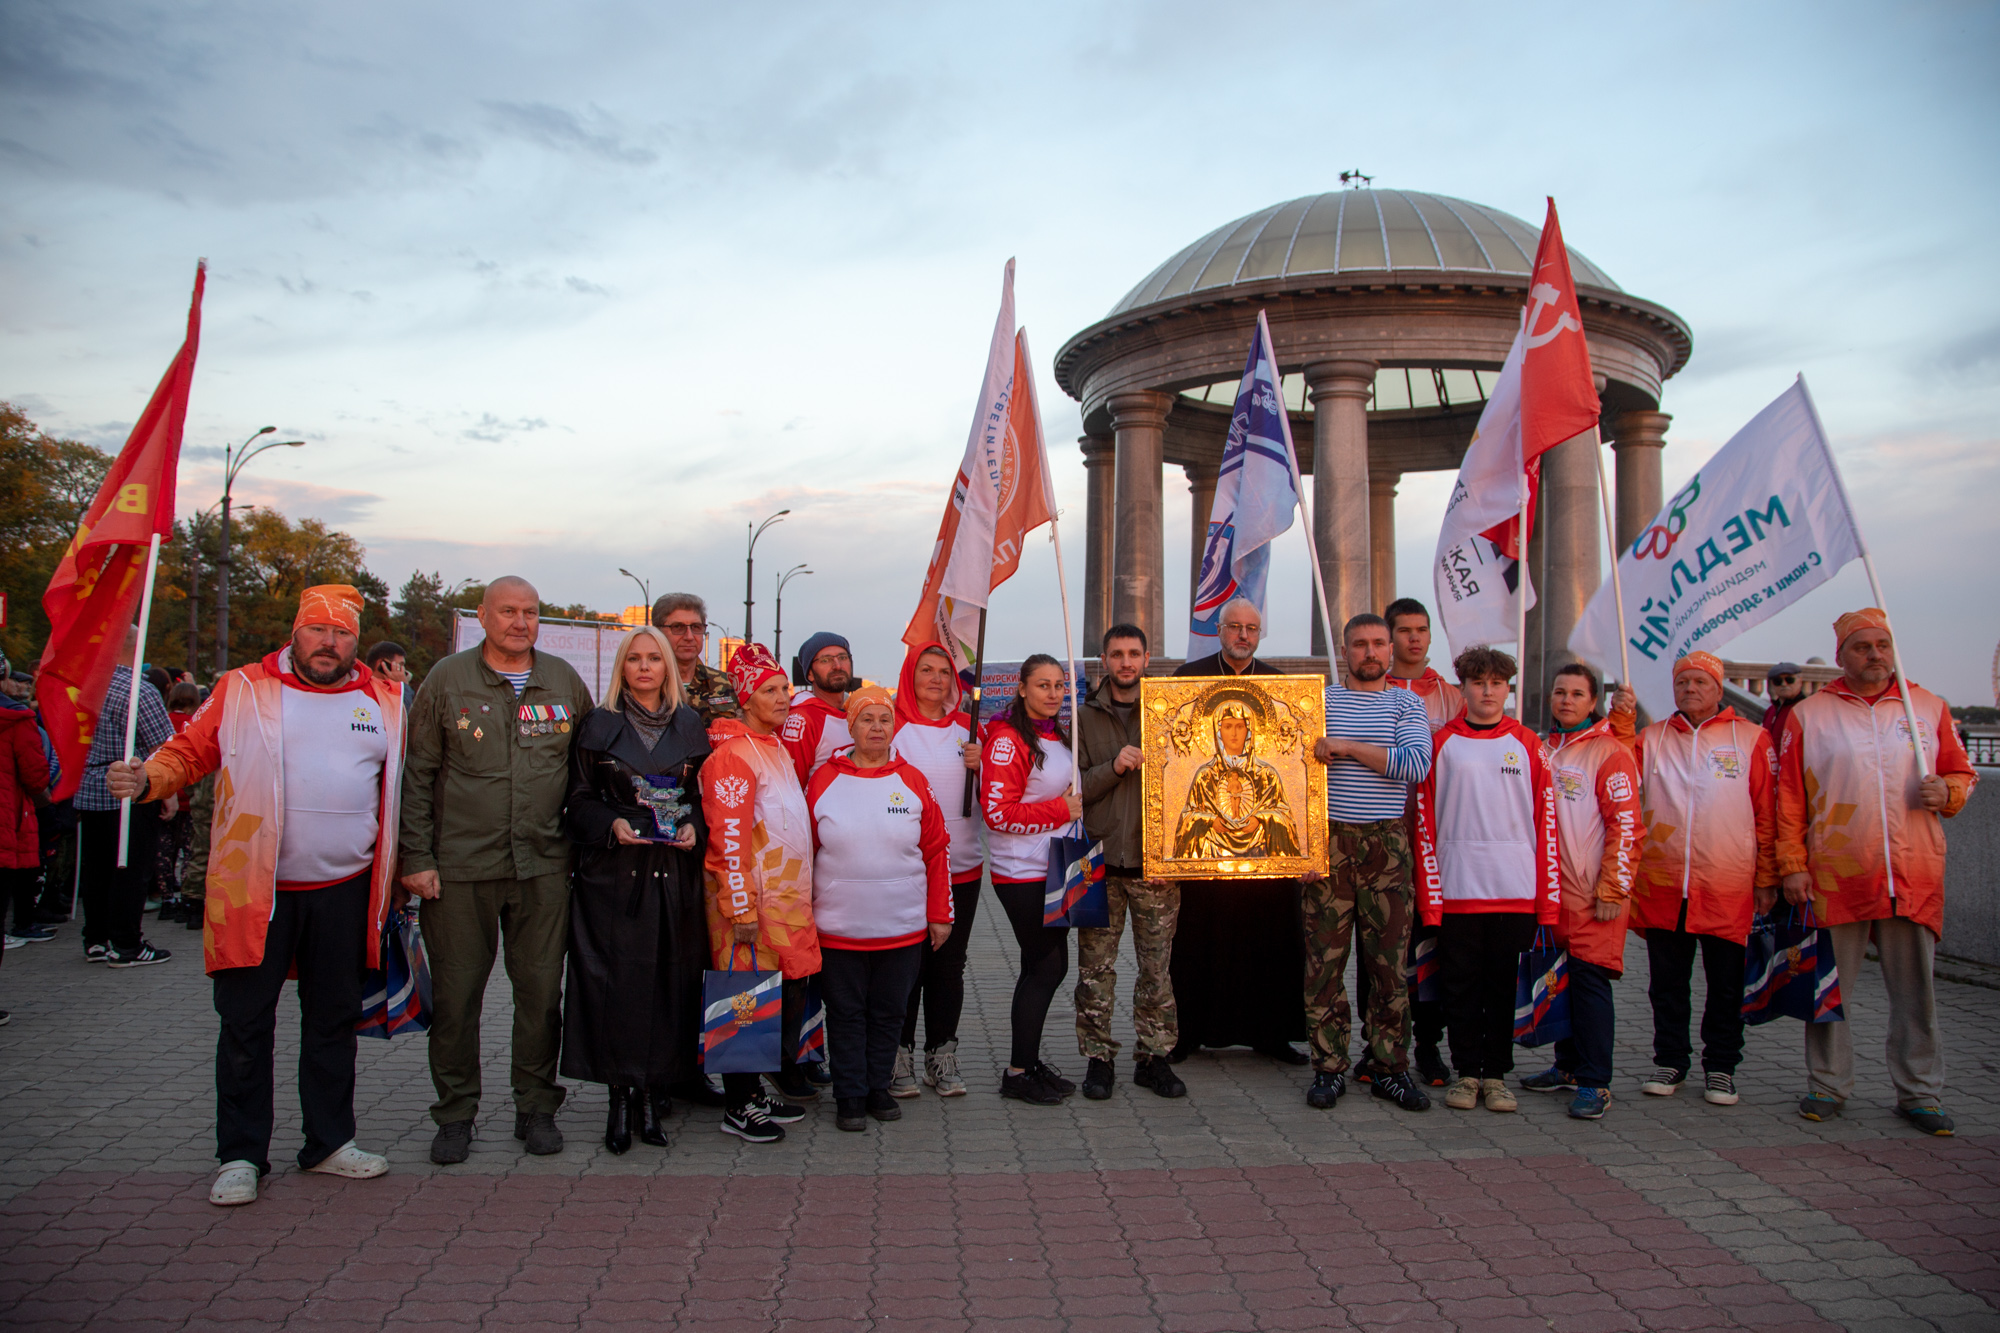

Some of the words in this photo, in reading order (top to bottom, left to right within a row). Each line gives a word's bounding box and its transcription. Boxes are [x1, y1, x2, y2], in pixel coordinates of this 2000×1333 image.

[351, 723, 379, 735] ННК
[1501, 766, 1522, 776] ННК
[887, 807, 910, 815] ННК
[987, 781, 1054, 835] МАРАФОН
[1542, 786, 1561, 904] АМУРСКИЙ
